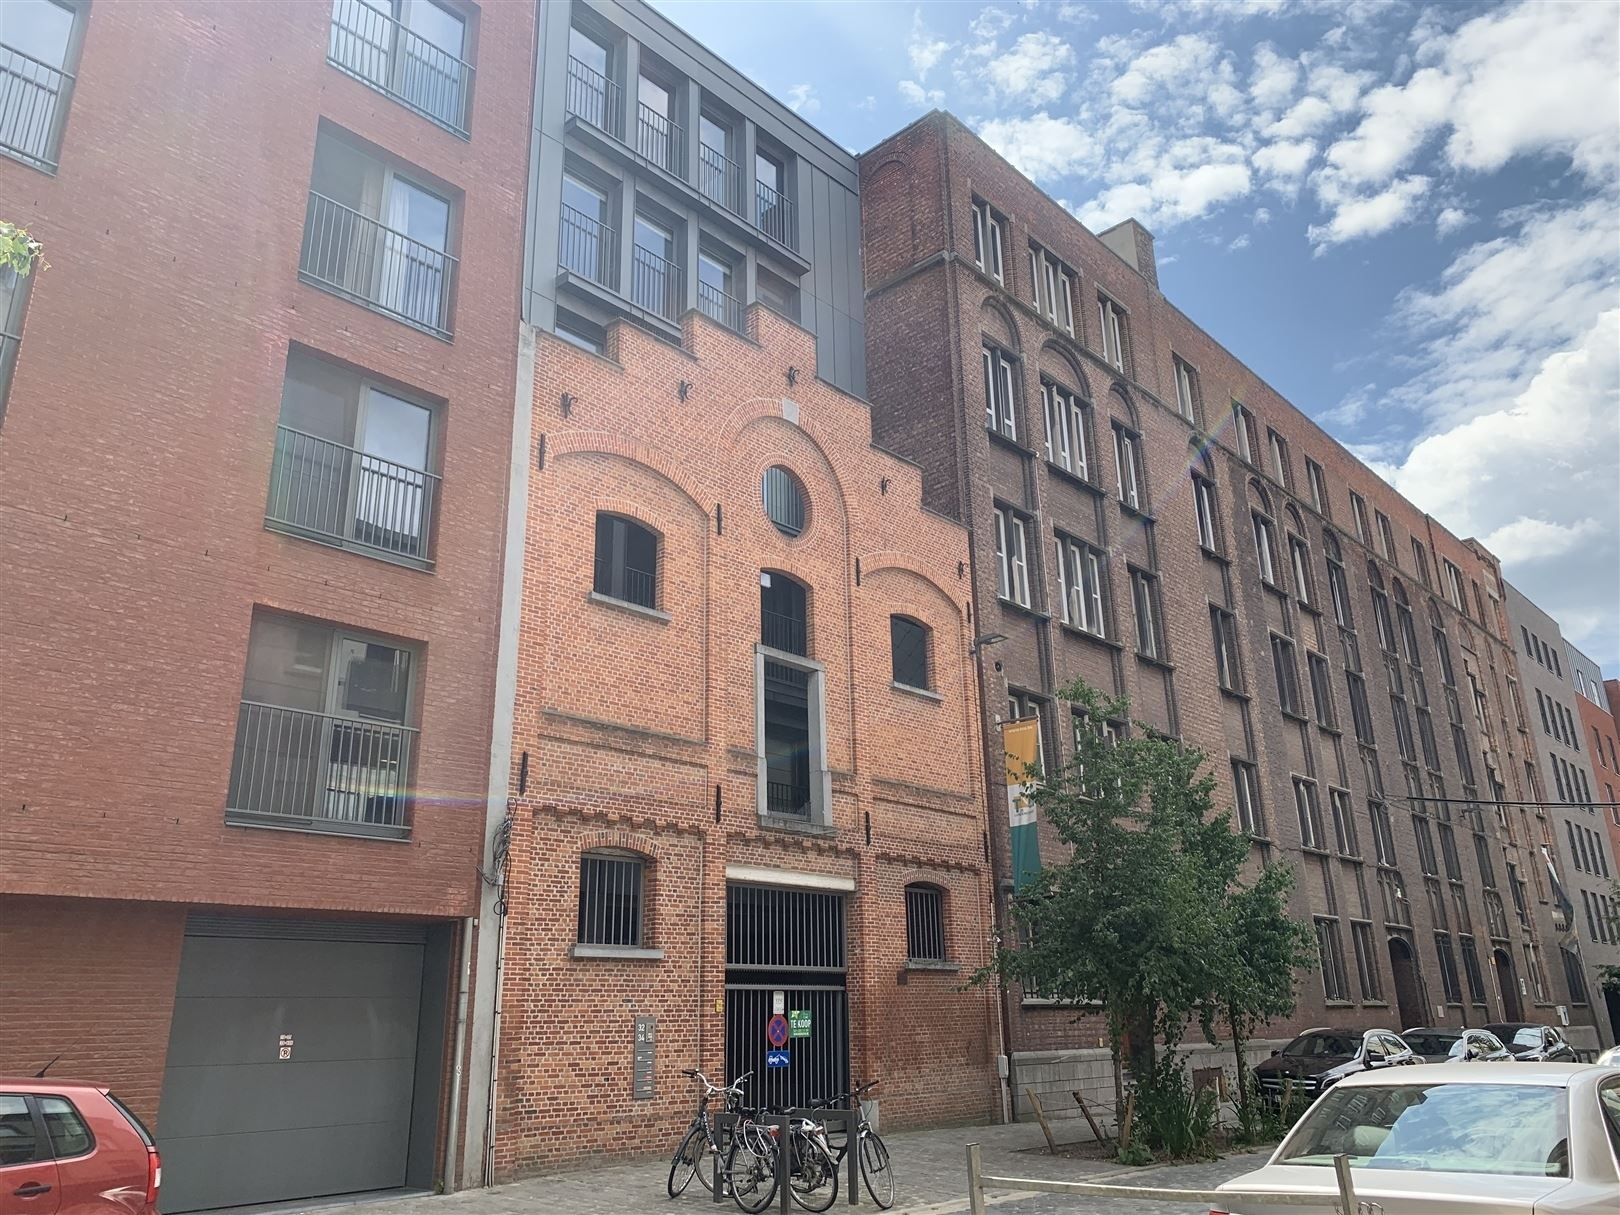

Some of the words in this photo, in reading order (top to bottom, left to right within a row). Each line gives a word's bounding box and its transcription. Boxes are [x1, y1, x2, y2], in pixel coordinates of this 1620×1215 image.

[638, 1023, 646, 1032] 32
[790, 1019, 797, 1029] TE
[797, 1019, 812, 1028] KOOP
[637, 1033, 645, 1042] 34
